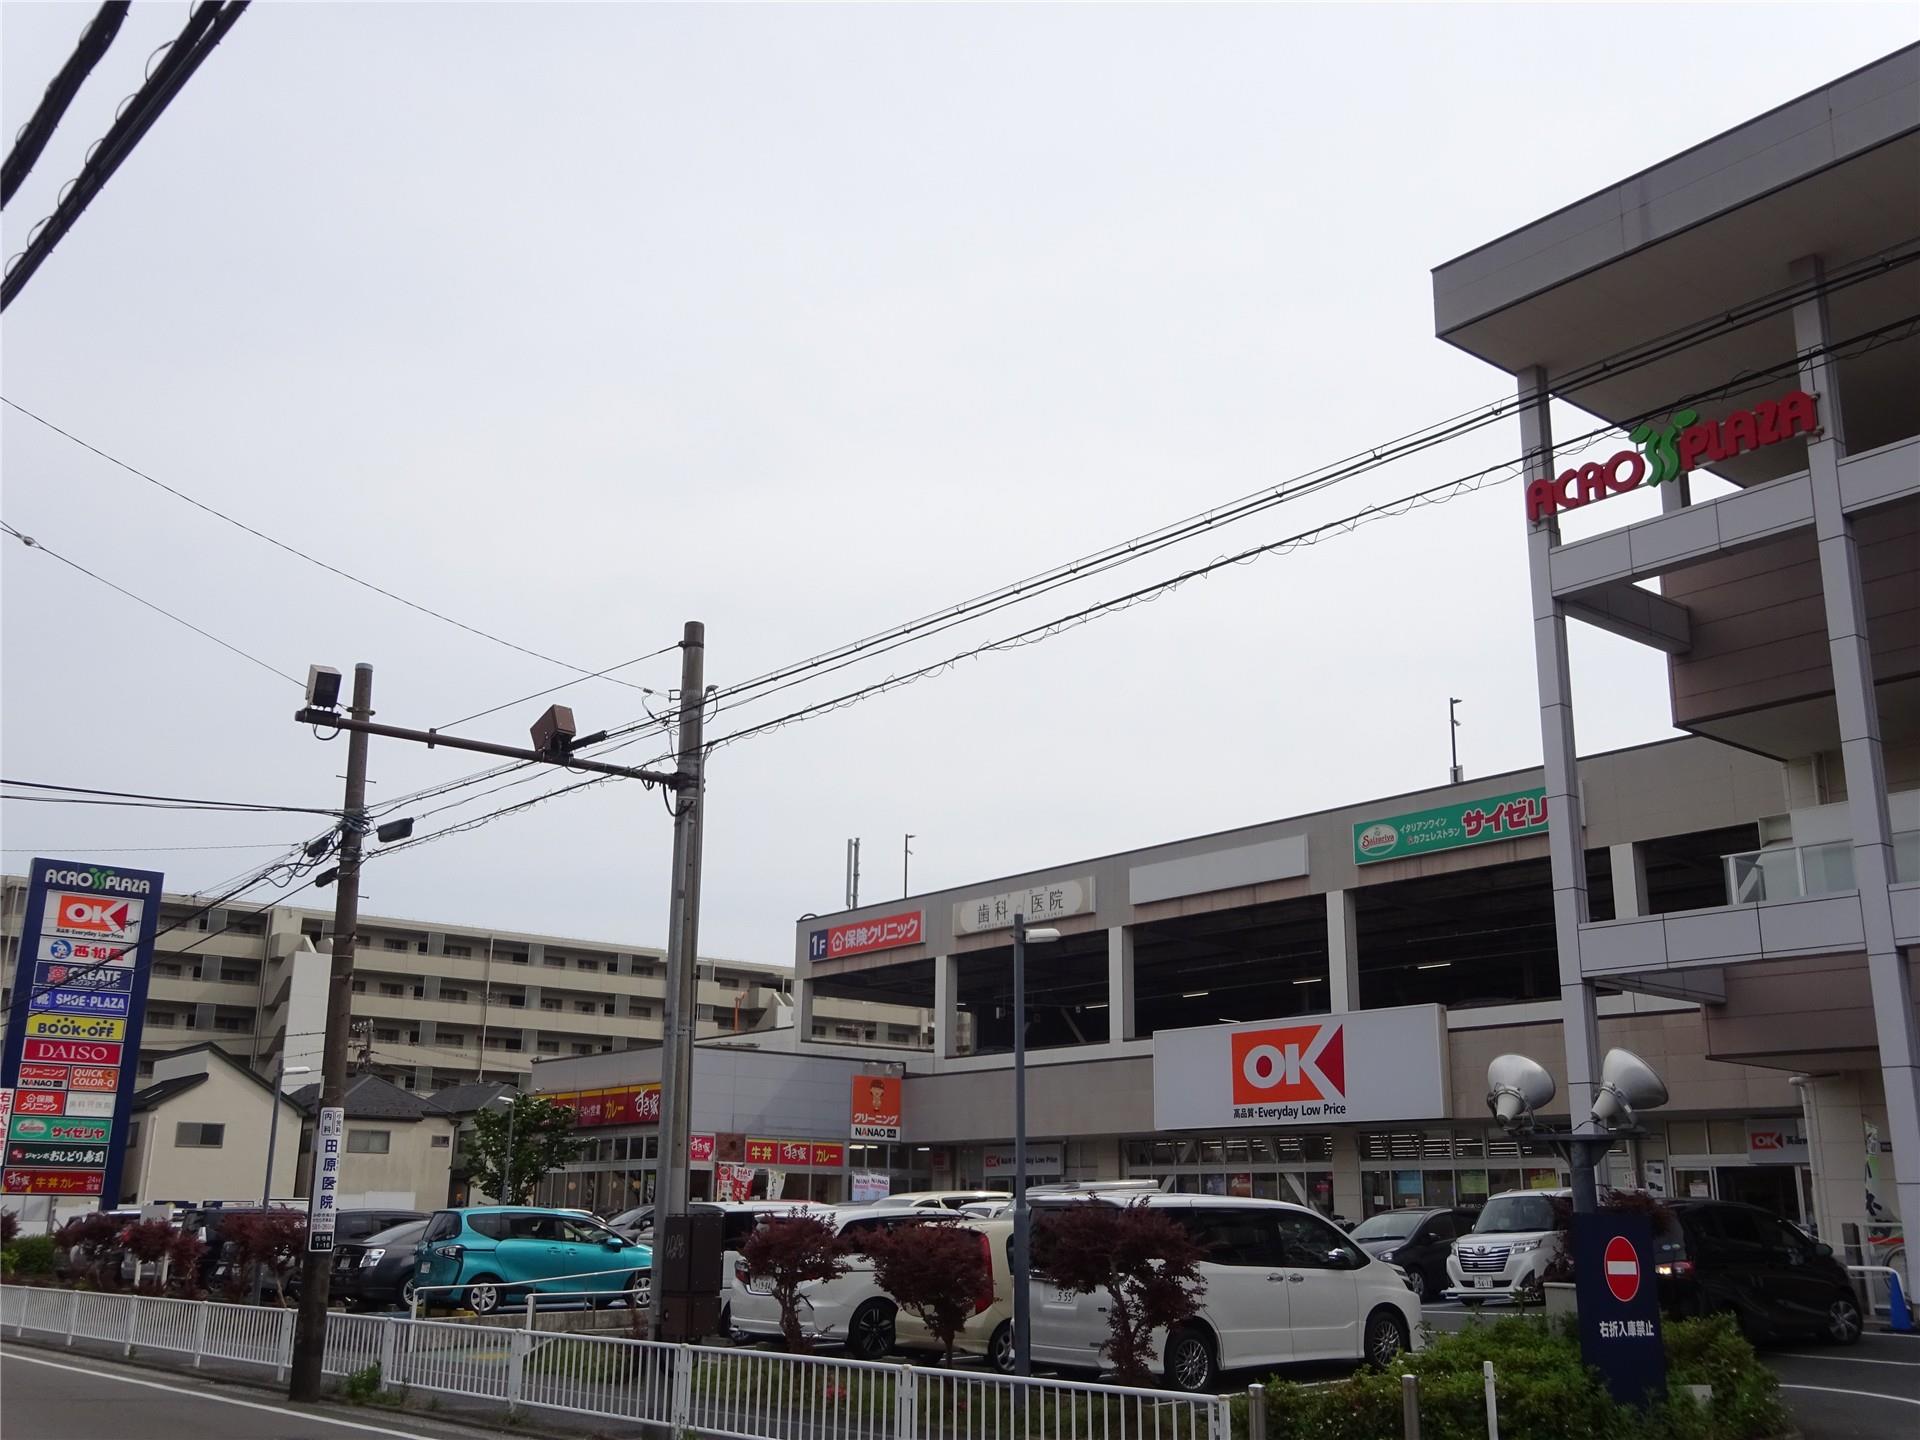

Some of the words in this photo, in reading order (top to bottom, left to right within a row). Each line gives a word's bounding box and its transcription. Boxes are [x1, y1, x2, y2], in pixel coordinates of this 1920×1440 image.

[1679, 390, 1817, 472] PLAZA
[1400, 817, 1447, 833] イタリアンワイン
[105, 876, 150, 894] PLAZA
[65, 901, 125, 930] OK
[811, 935, 826, 956] 1F
[845, 918, 918, 948] 保険クリニック
[39, 1043, 108, 1060] DAISO
[1242, 1028, 1336, 1097] OK
[22, 1067, 66, 1077] クリーニング
[74, 1070, 103, 1078] QUICK
[21, 1079, 52, 1088] NANAO
[72, 1077, 115, 1087] COLOR-Q
[21, 1102, 58, 1112] クリニック
[605, 1100, 625, 1119] カレー
[635, 1087, 660, 1119] すき家
[1301, 1105, 1321, 1116] Low
[1323, 1102, 1346, 1115] Price
[325, 1112, 333, 1134] 内科
[854, 1113, 898, 1125] クリーニング
[51, 1127, 106, 1140] サイゼリヤ
[855, 1127, 886, 1137] NANAO
[690, 1138, 711, 1153] すき家
[1755, 1133, 1780, 1148] OK
[751, 1146, 773, 1160] 牛丼
[783, 1143, 807, 1160] すき家
[816, 1150, 838, 1163] カレー
[320, 1139, 338, 1210] 田原医院
[1599, 1320, 1655, 1338] 右折入庫禁止
